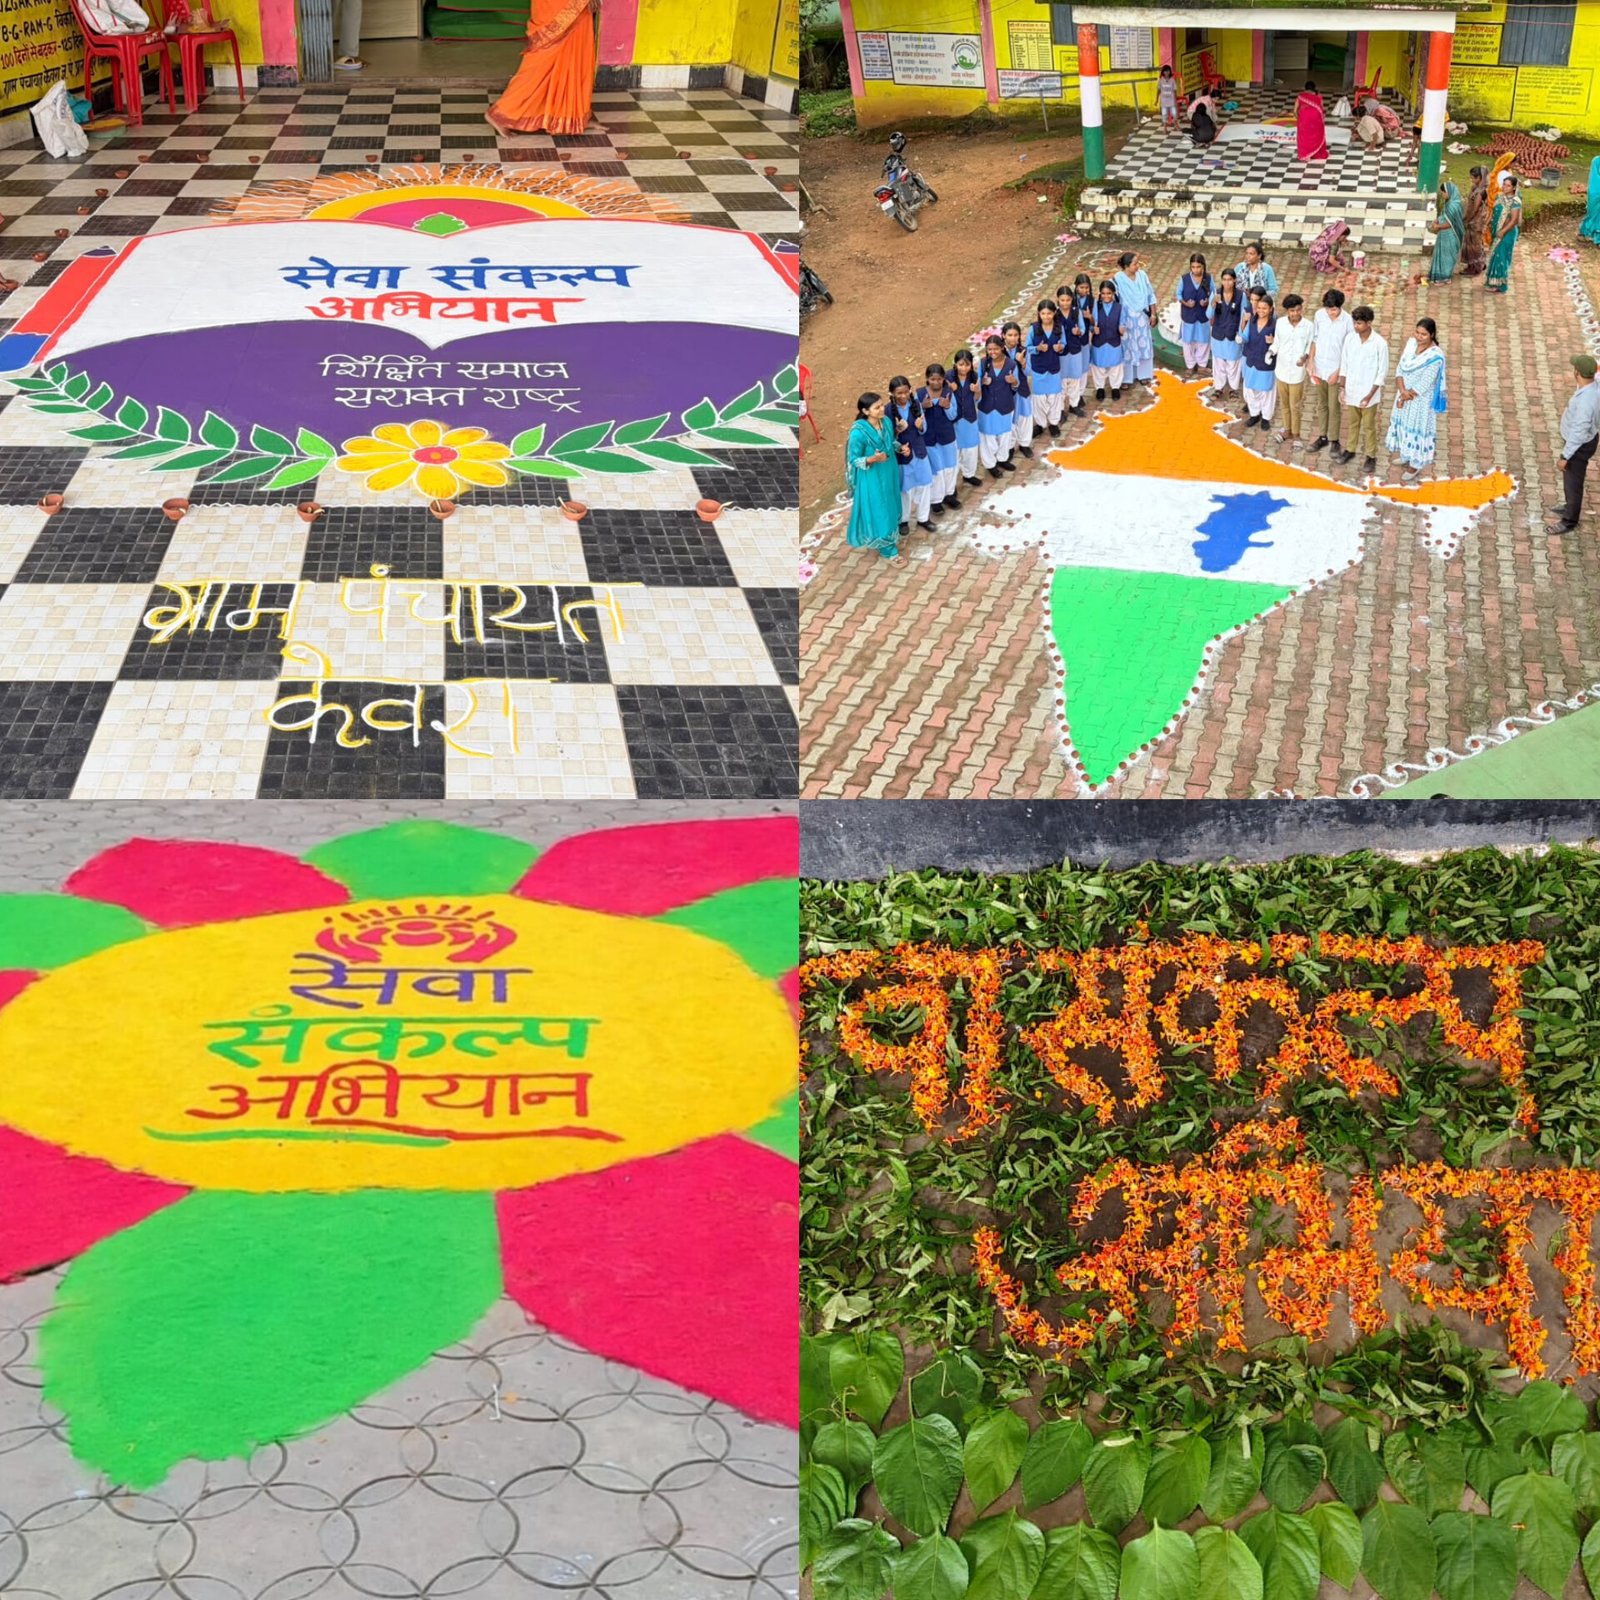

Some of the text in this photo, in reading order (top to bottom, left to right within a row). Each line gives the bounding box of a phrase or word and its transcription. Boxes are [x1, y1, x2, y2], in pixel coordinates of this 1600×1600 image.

[278, 256, 643, 291] सेवा संकल्प
[305, 291, 587, 324] अभियान
[456, 361, 570, 380] समाज
[334, 386, 582, 413] सशक्त राष्ट्र
[143, 563, 645, 646] ग्राम पंचायत
[263, 641, 558, 758] केवरा
[290, 953, 534, 1009] सेवा
[203, 1004, 602, 1068] संकल्प
[185, 1059, 593, 1121] अभियान
